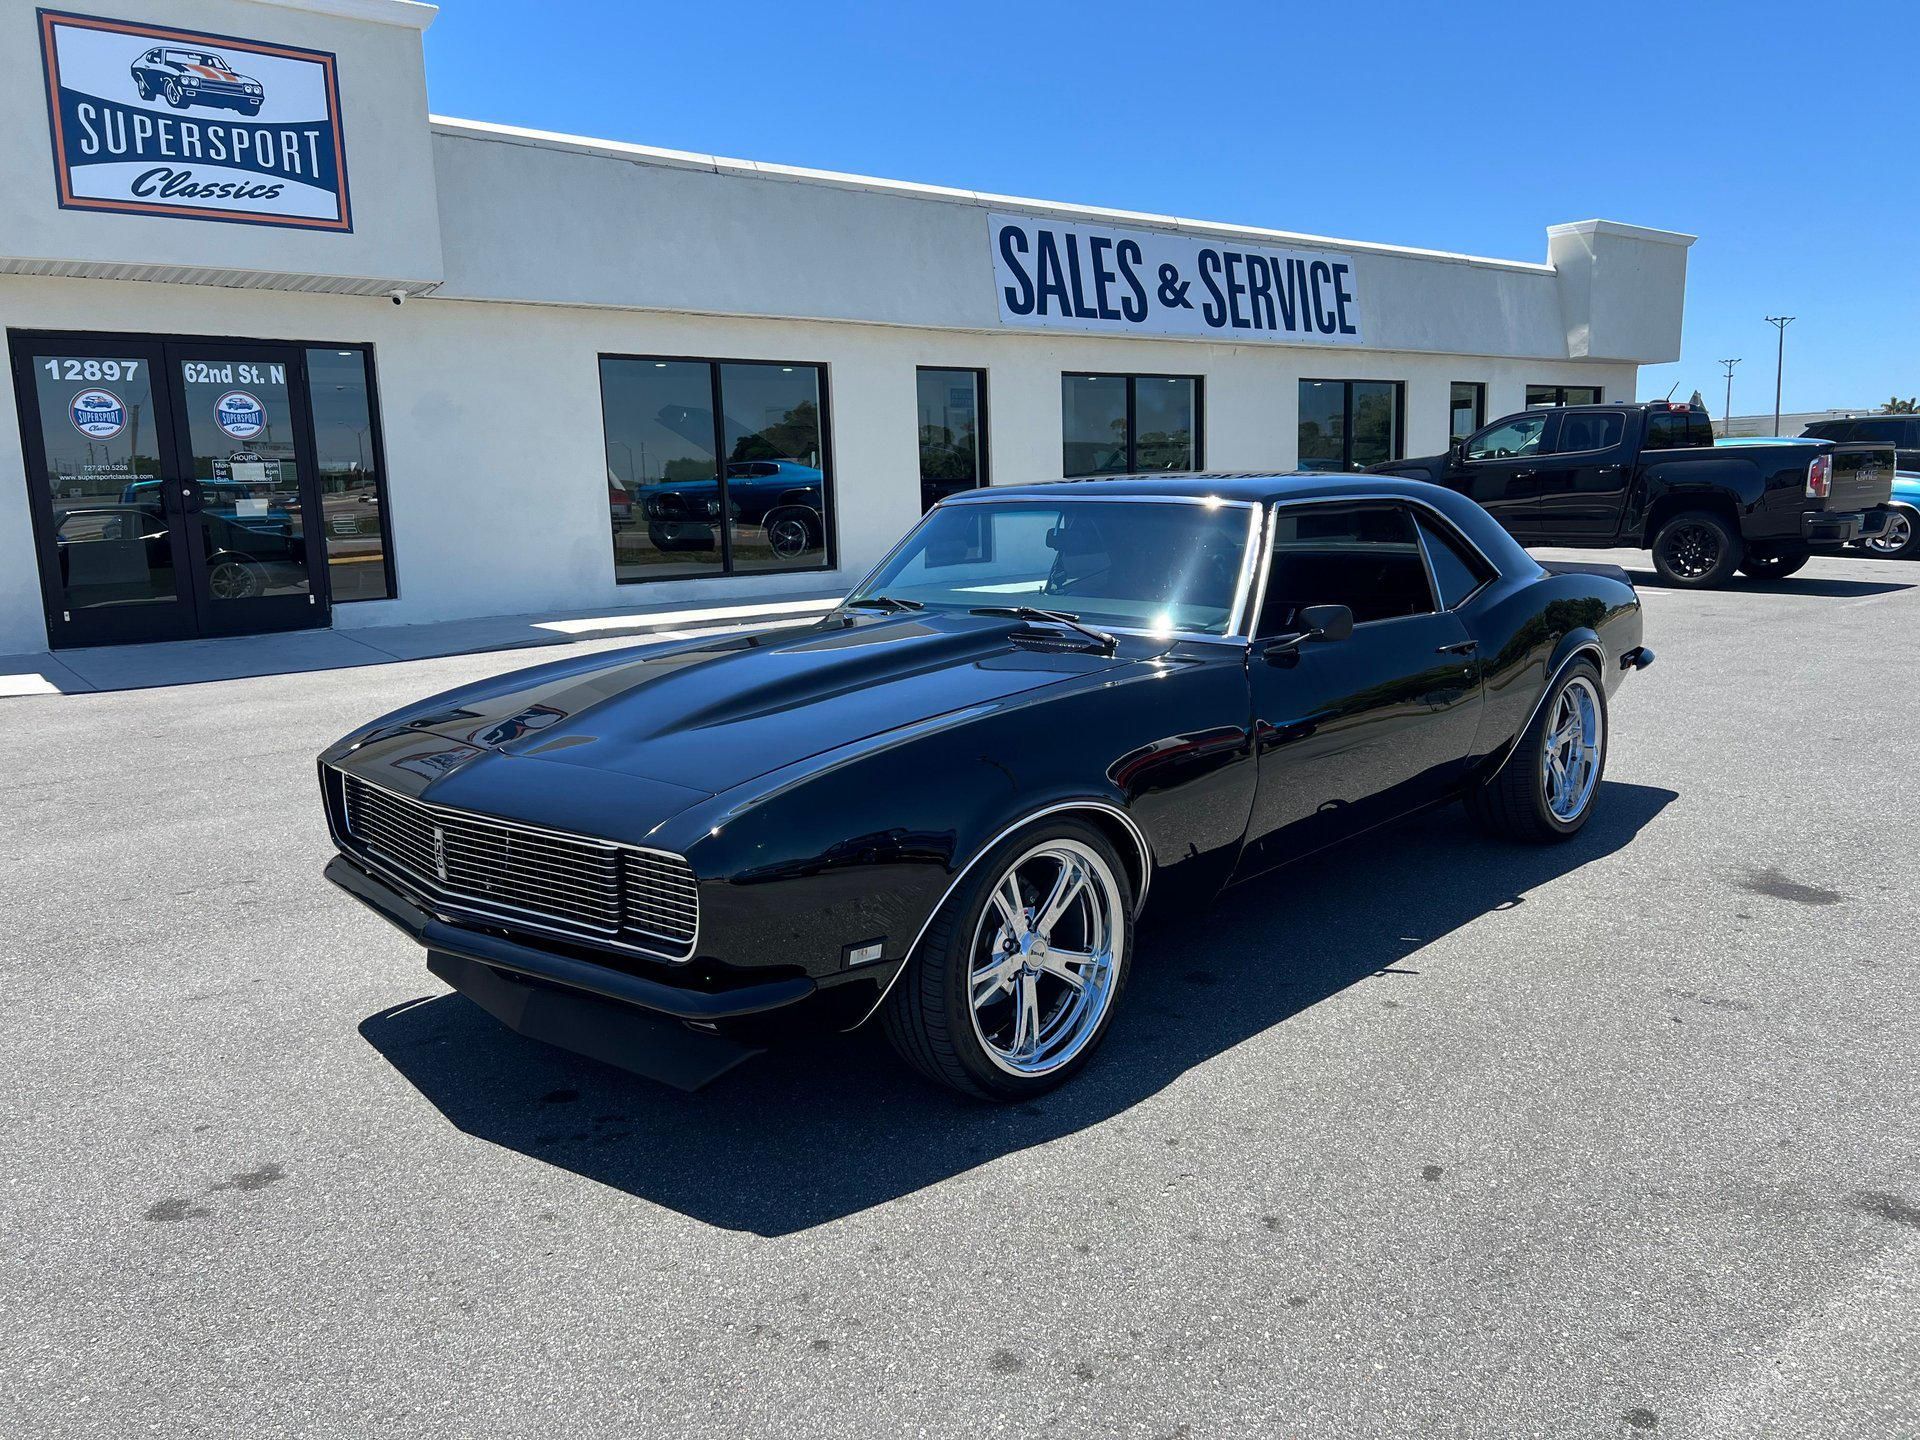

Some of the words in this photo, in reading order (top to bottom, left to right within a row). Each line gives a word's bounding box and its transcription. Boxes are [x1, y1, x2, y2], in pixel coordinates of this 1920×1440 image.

[78, 102, 320, 179] SUPERSPORT
[130, 167, 285, 199] Classics
[999, 225, 1148, 323] SALES
[1157, 263, 1194, 310] &
[1198, 248, 1357, 335] SERVICE
[45, 359, 139, 381] 12897
[184, 363, 233, 384] 62nd
[238, 364, 265, 384] St.
[270, 365, 285, 385] N
[78, 410, 120, 424] SUPERSPORT
[88, 424, 114, 432] Classics
[221, 412, 261, 425] SUPERSPORT
[58, 473, 154, 481] www.supersportclassics.com
